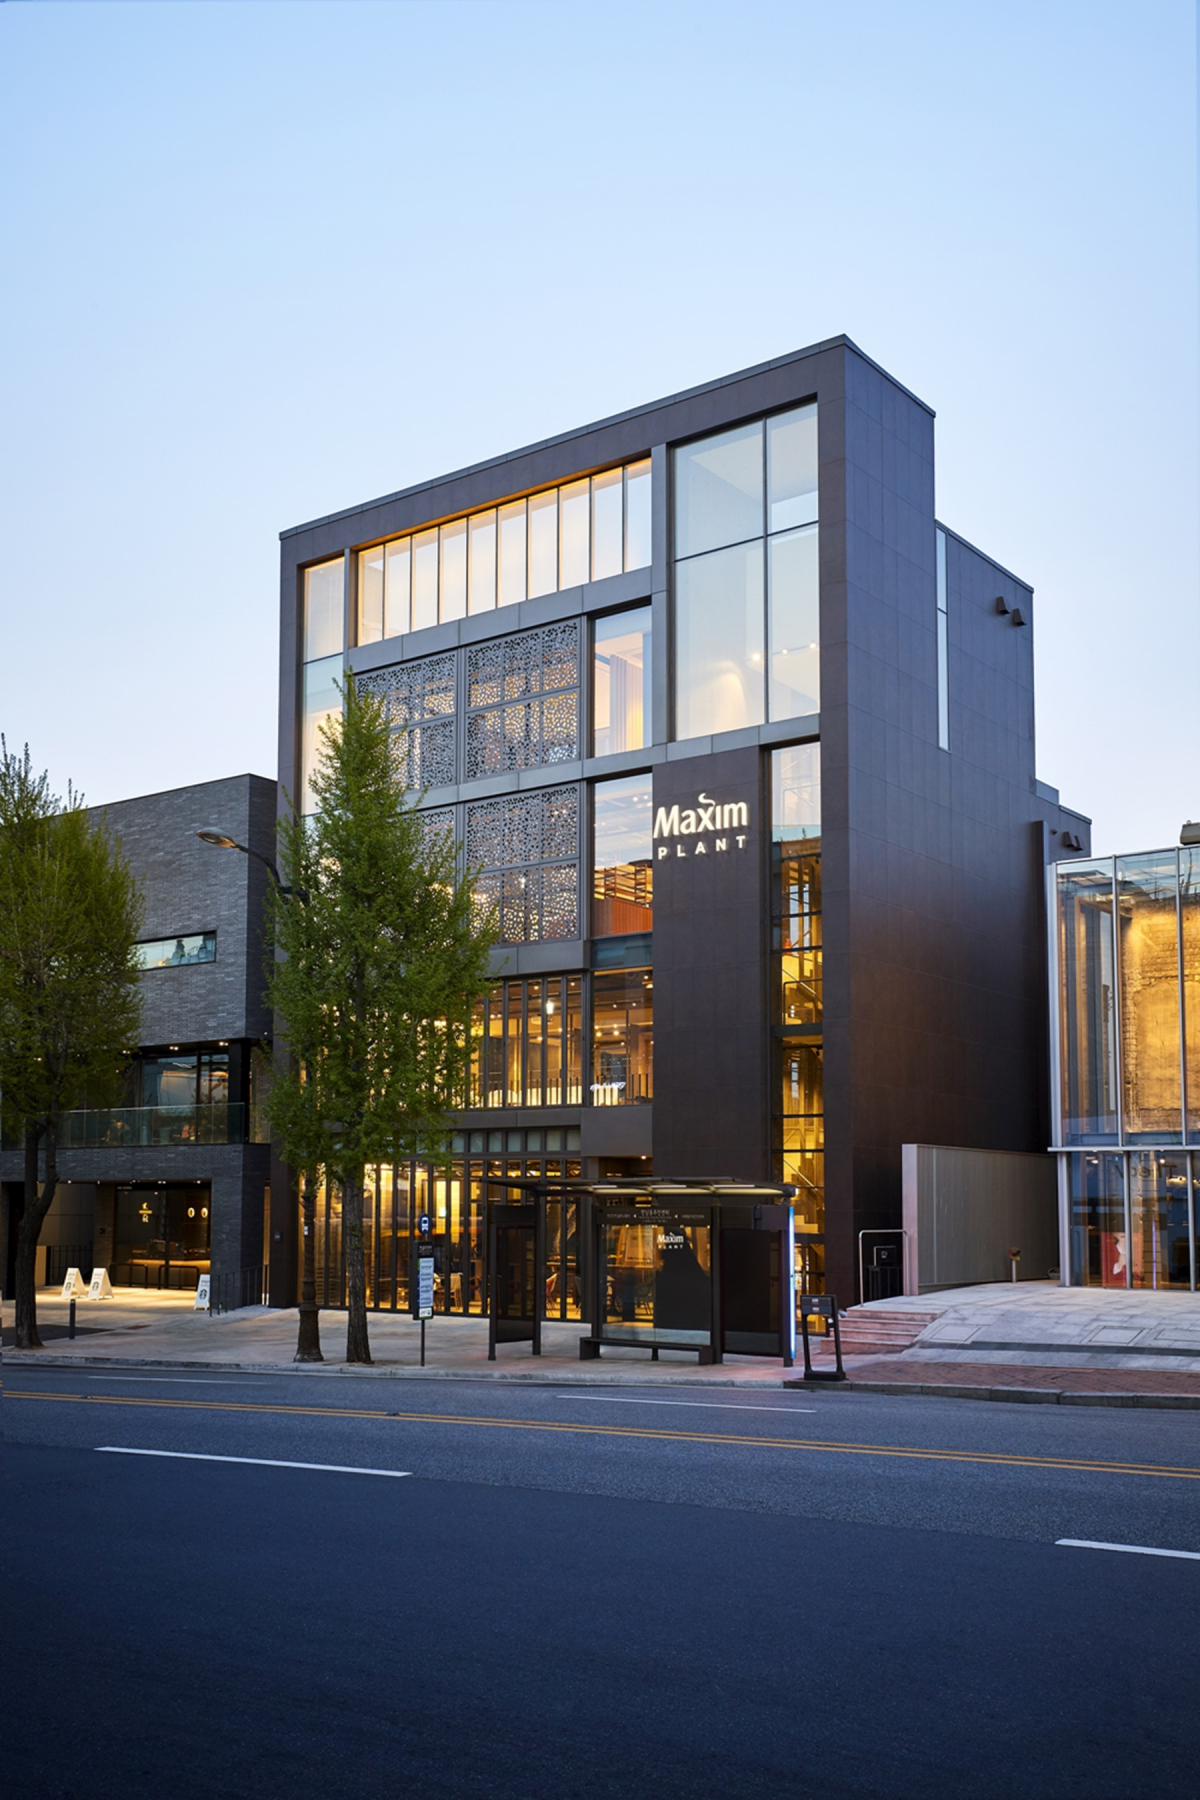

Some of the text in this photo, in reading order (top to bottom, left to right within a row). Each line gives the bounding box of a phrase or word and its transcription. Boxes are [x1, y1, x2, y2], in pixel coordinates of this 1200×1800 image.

[653, 793, 748, 839] Maxim
[658, 835, 746, 860] PLANT
[657, 1231, 684, 1243] Maxim
